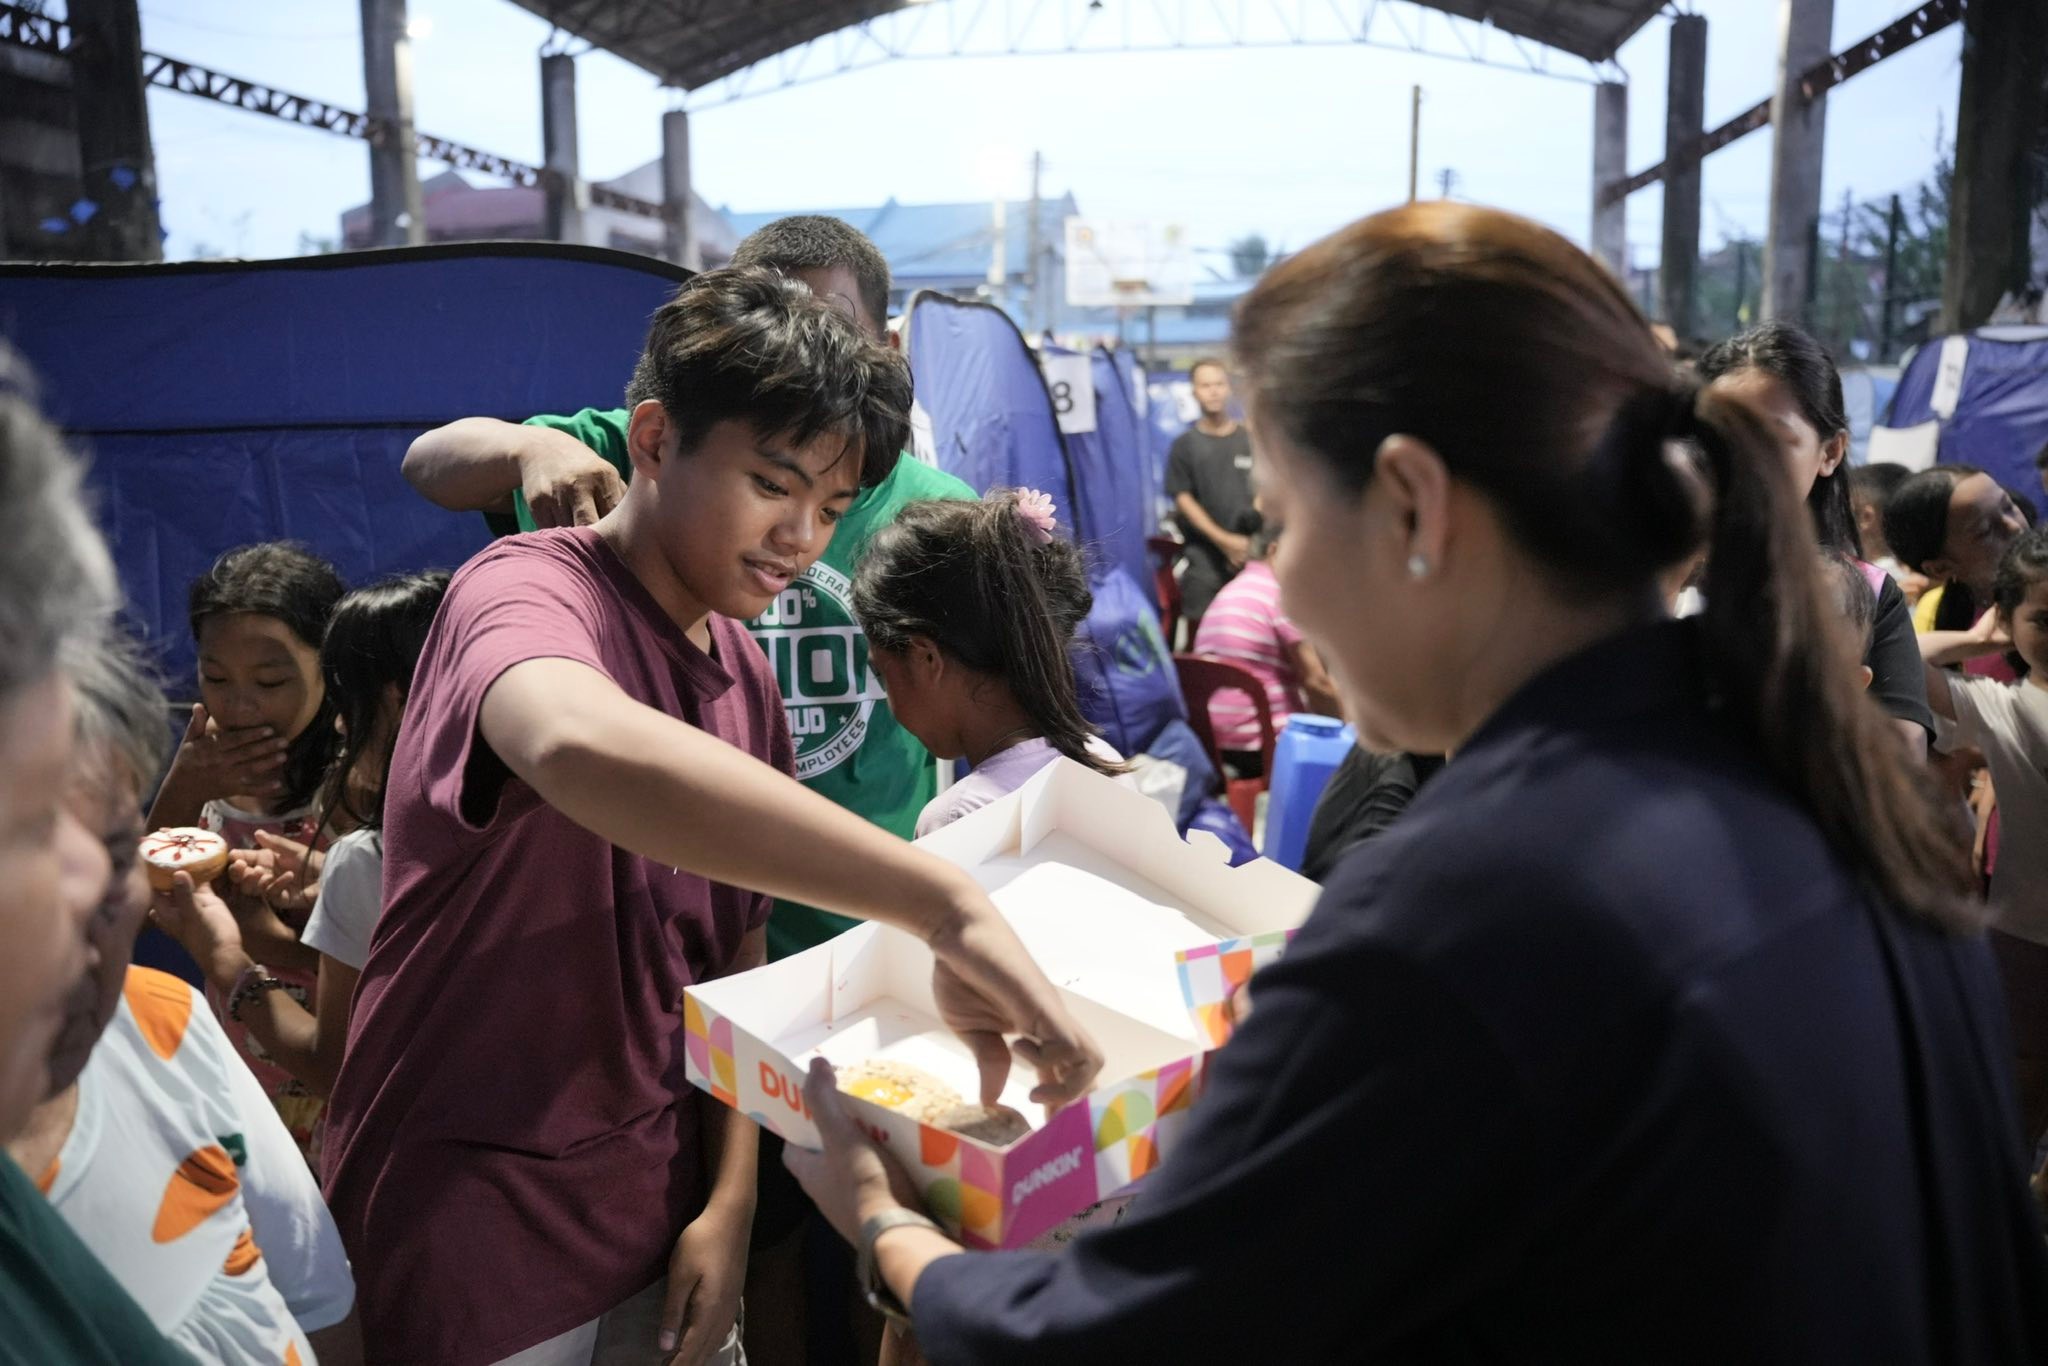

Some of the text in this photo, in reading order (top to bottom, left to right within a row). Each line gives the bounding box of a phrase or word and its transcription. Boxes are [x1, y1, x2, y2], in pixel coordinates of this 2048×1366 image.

[1052, 381, 1074, 414] 8
[752, 588, 817, 626] 00%
[796, 718, 866, 774] MPLOYEES
